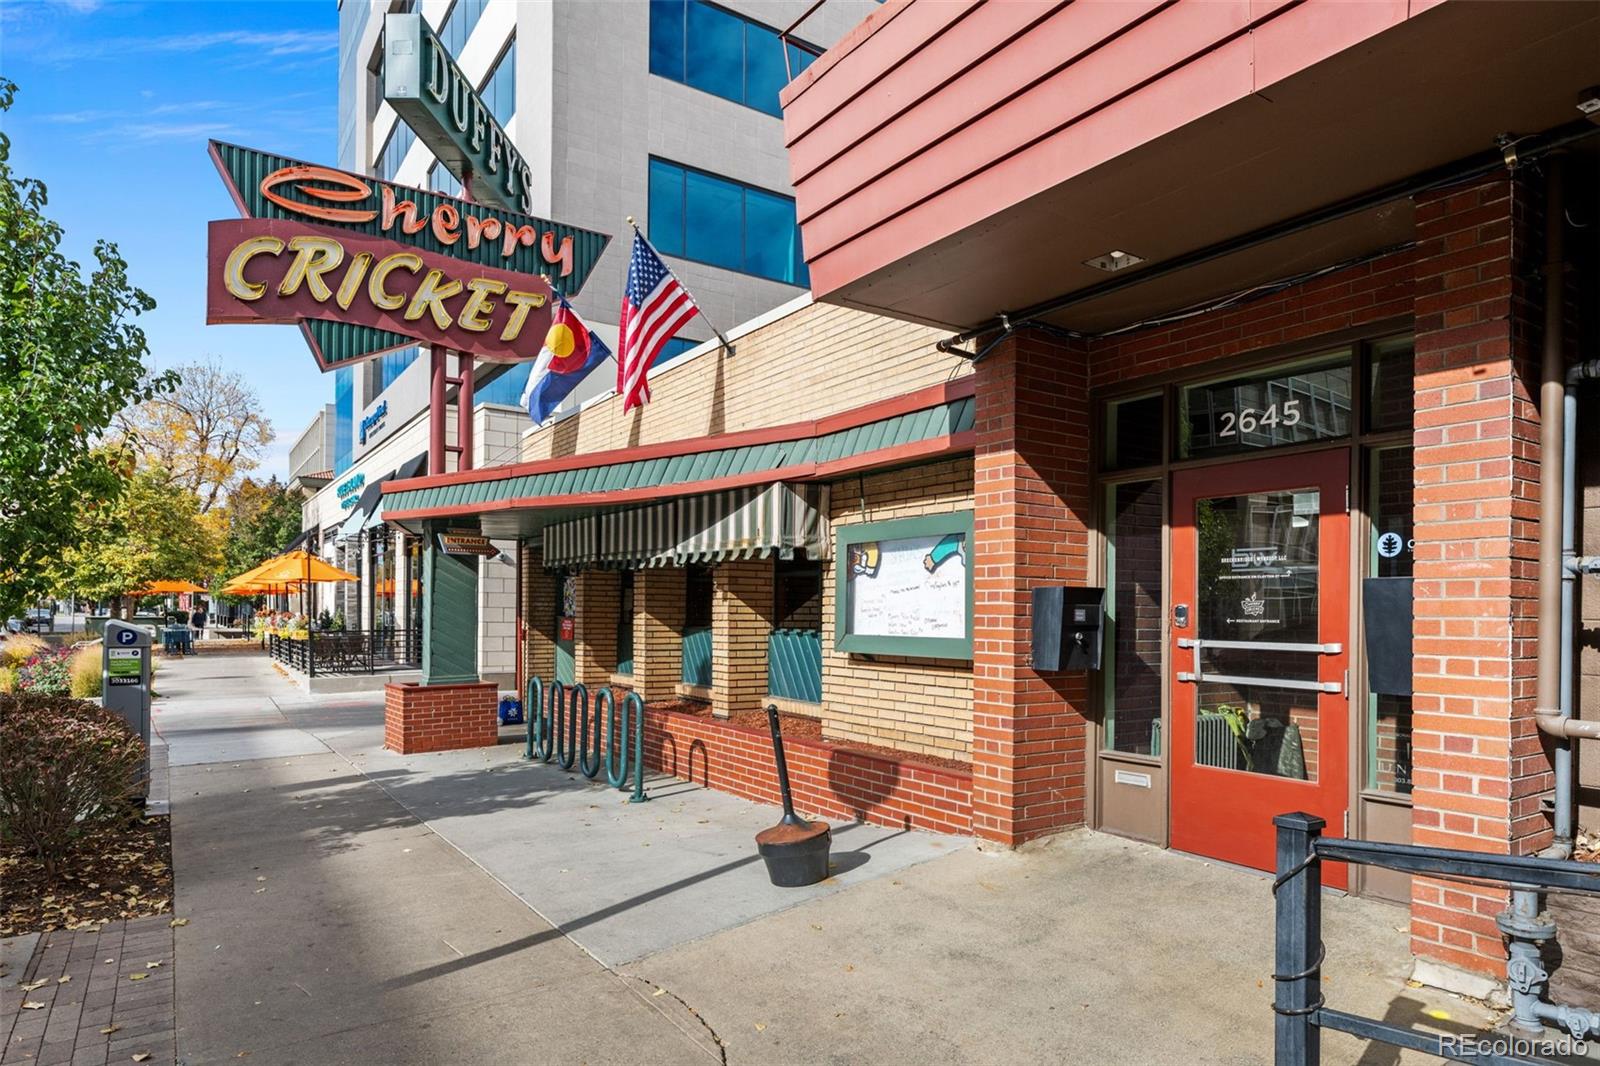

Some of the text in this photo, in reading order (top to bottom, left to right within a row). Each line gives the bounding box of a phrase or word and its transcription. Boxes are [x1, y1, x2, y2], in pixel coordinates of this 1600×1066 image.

[427, 34, 533, 216] DUFFY'S
[259, 165, 575, 278] Cherry
[223, 235, 546, 342] CRICKET
[1219, 400, 1301, 437] 2645
[447, 537, 485, 545] ENTRANCE
[122, 632, 133, 642] P
